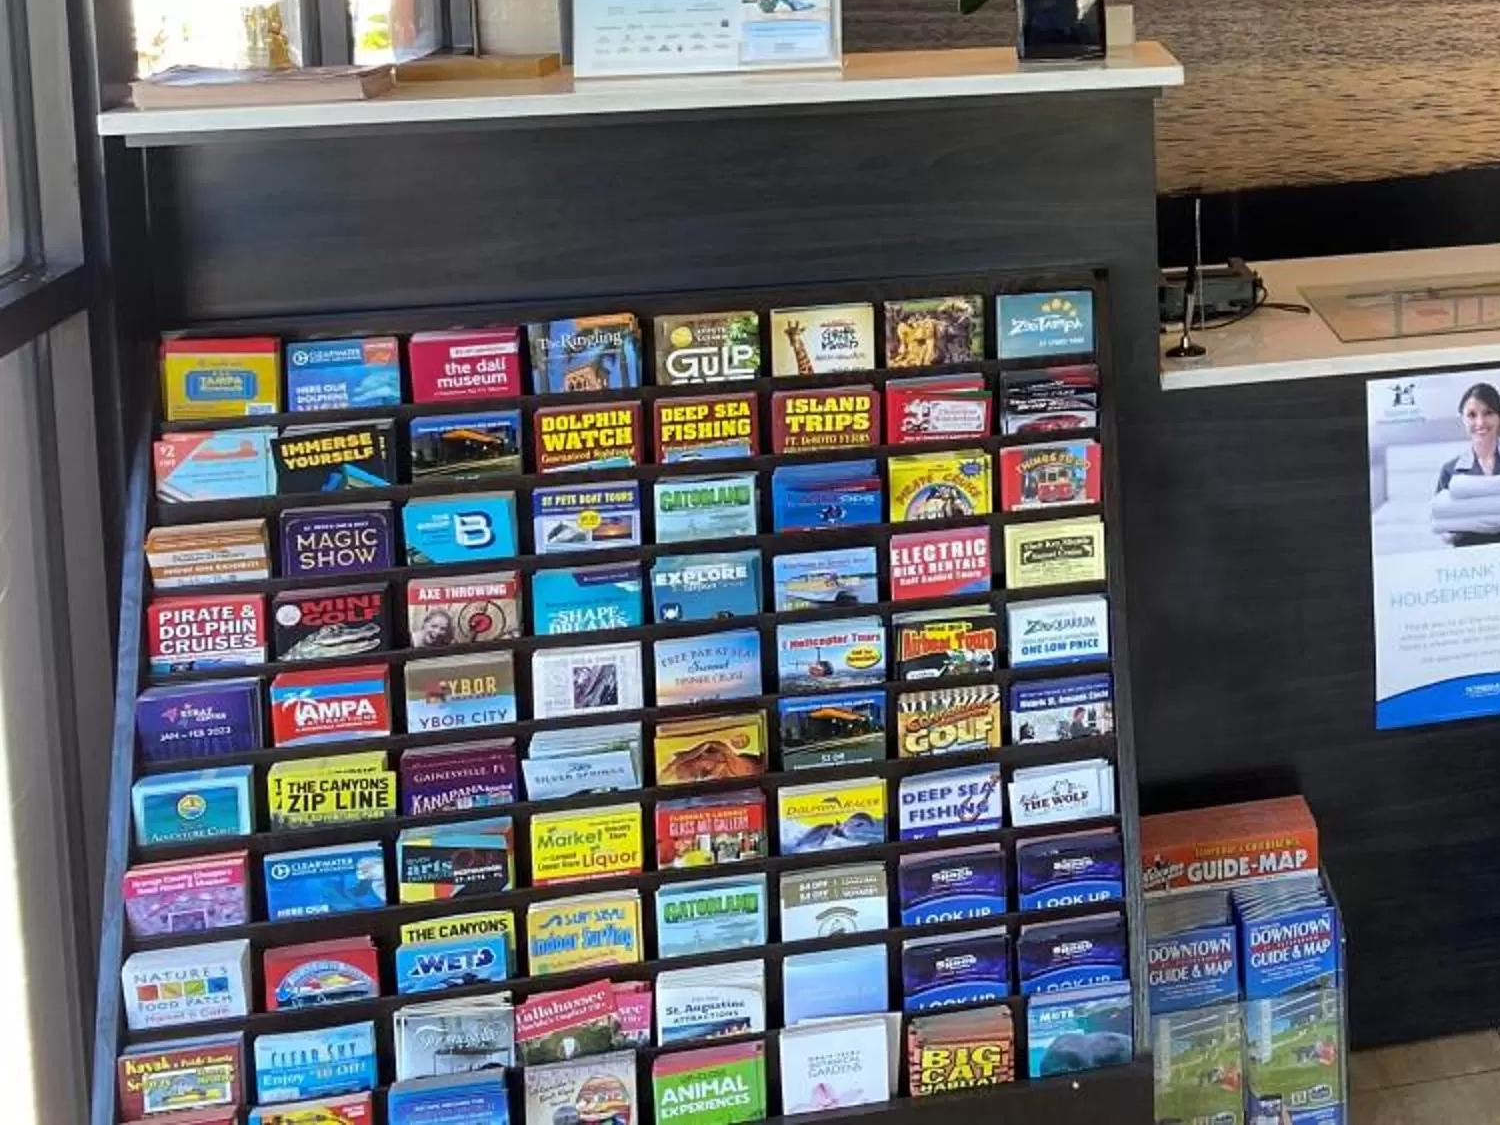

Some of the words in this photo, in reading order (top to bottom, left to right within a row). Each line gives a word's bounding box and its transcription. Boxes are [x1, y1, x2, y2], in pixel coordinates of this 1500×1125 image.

[560, 330, 623, 351] Ringling
[445, 361, 471, 375] the
[437, 373, 507, 388] museum
[661, 406, 709, 423] DEEP
[715, 401, 749, 418] SEA
[786, 396, 871, 414] ISLAND
[541, 410, 632, 433] DOLPHIN
[662, 418, 751, 442] FISHING
[786, 413, 870, 433] TRIPS
[281, 432, 372, 457] IMMERSE
[541, 427, 633, 452] WATCH
[283, 447, 375, 470] YOURSELF
[296, 528, 378, 551] MAGIC
[299, 547, 377, 570] SHOW
[891, 538, 987, 566] ELECTRIC
[655, 566, 747, 587] EXPLORE
[893, 563, 924, 579] BIKE
[929, 556, 986, 573] RENTALS
[1436, 565, 1495, 585] THANK
[418, 588, 441, 600] AXE
[444, 584, 507, 599] THROWING
[159, 606, 234, 624] PIRATE
[241, 604, 256, 618] &
[302, 594, 381, 613] MINI
[301, 609, 379, 625] GOLF
[559, 605, 619, 624] SHAPE
[159, 620, 257, 640] DOLPHIN
[160, 634, 257, 654] CRUISES
[1021, 645, 1043, 656] ONE
[1044, 643, 1067, 652] LOW
[1070, 638, 1099, 649] PRICE
[449, 676, 497, 695] YBOR
[419, 715, 465, 729] YBOR
[472, 709, 508, 724] CITY
[905, 716, 994, 753] GOLF
[288, 781, 316, 794] THE
[320, 778, 389, 791] CANYONS
[902, 788, 953, 805] DEEP
[958, 781, 996, 797] SEA
[288, 794, 325, 813] ZIP
[335, 791, 391, 809] LINE
[1023, 798, 1050, 811] THE
[1051, 790, 1089, 807] WOLF
[909, 801, 990, 822] FISHING
[537, 829, 603, 850] Market
[407, 860, 453, 876] arts
[582, 850, 638, 868] Liquor
[1187, 848, 1309, 884] GUIDE-MAP
[1037, 895, 1083, 910] LOOK
[1088, 890, 1111, 902] UP
[969, 906, 991, 918] UP
[408, 928, 435, 941] THE
[439, 919, 508, 937] CANYONS
[1250, 918, 1332, 946] DOWNTOWN
[1149, 938, 1232, 964] DOWNTOWN
[1251, 948, 1289, 968] GUIDE
[1292, 945, 1302, 960] &
[1304, 938, 1332, 956] MAP
[1149, 965, 1189, 986] GUIDE
[1192, 964, 1201, 979] &
[1204, 960, 1233, 976] MAP
[185, 996, 233, 1007] PATCH
[686, 1000, 745, 1014] Augustine
[125, 1057, 170, 1076] Kayak
[923, 1045, 1002, 1068] BIG
[922, 1063, 994, 1084] CAT
[662, 1075, 748, 1106] ANIMAL
[920, 1077, 998, 1094] HABITAT
[661, 1093, 750, 1118] EXPERIENCES
